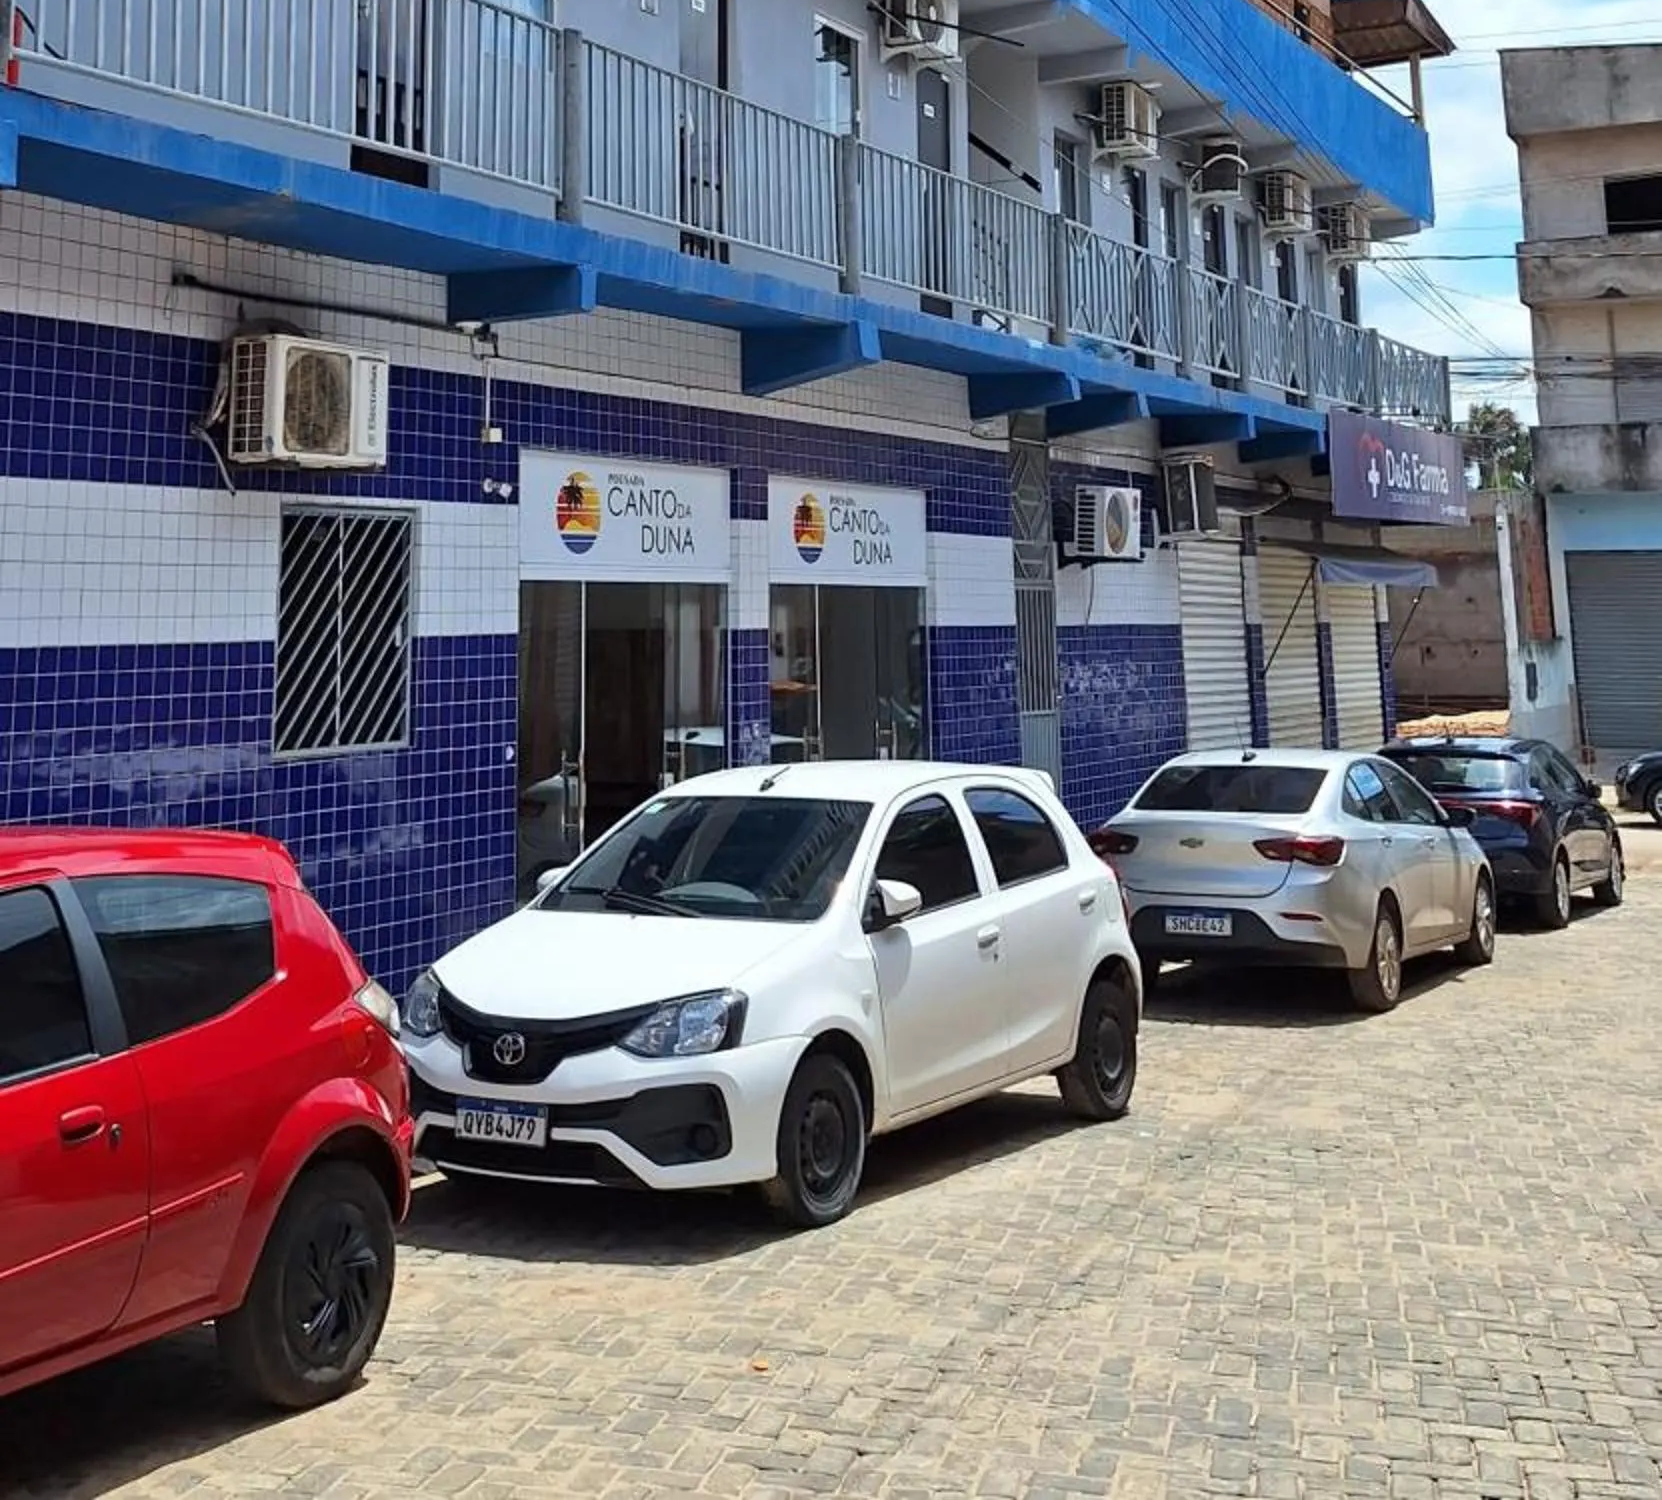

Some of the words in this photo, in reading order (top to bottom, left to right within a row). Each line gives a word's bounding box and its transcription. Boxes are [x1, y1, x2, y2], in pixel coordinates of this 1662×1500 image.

[1412, 453, 1449, 494] Farma
[607, 485, 677, 519] CANTO
[677, 503, 692, 518] DA
[829, 506, 878, 535] CANTO
[641, 524, 695, 555] DUNA
[853, 538, 893, 566] DUNA
